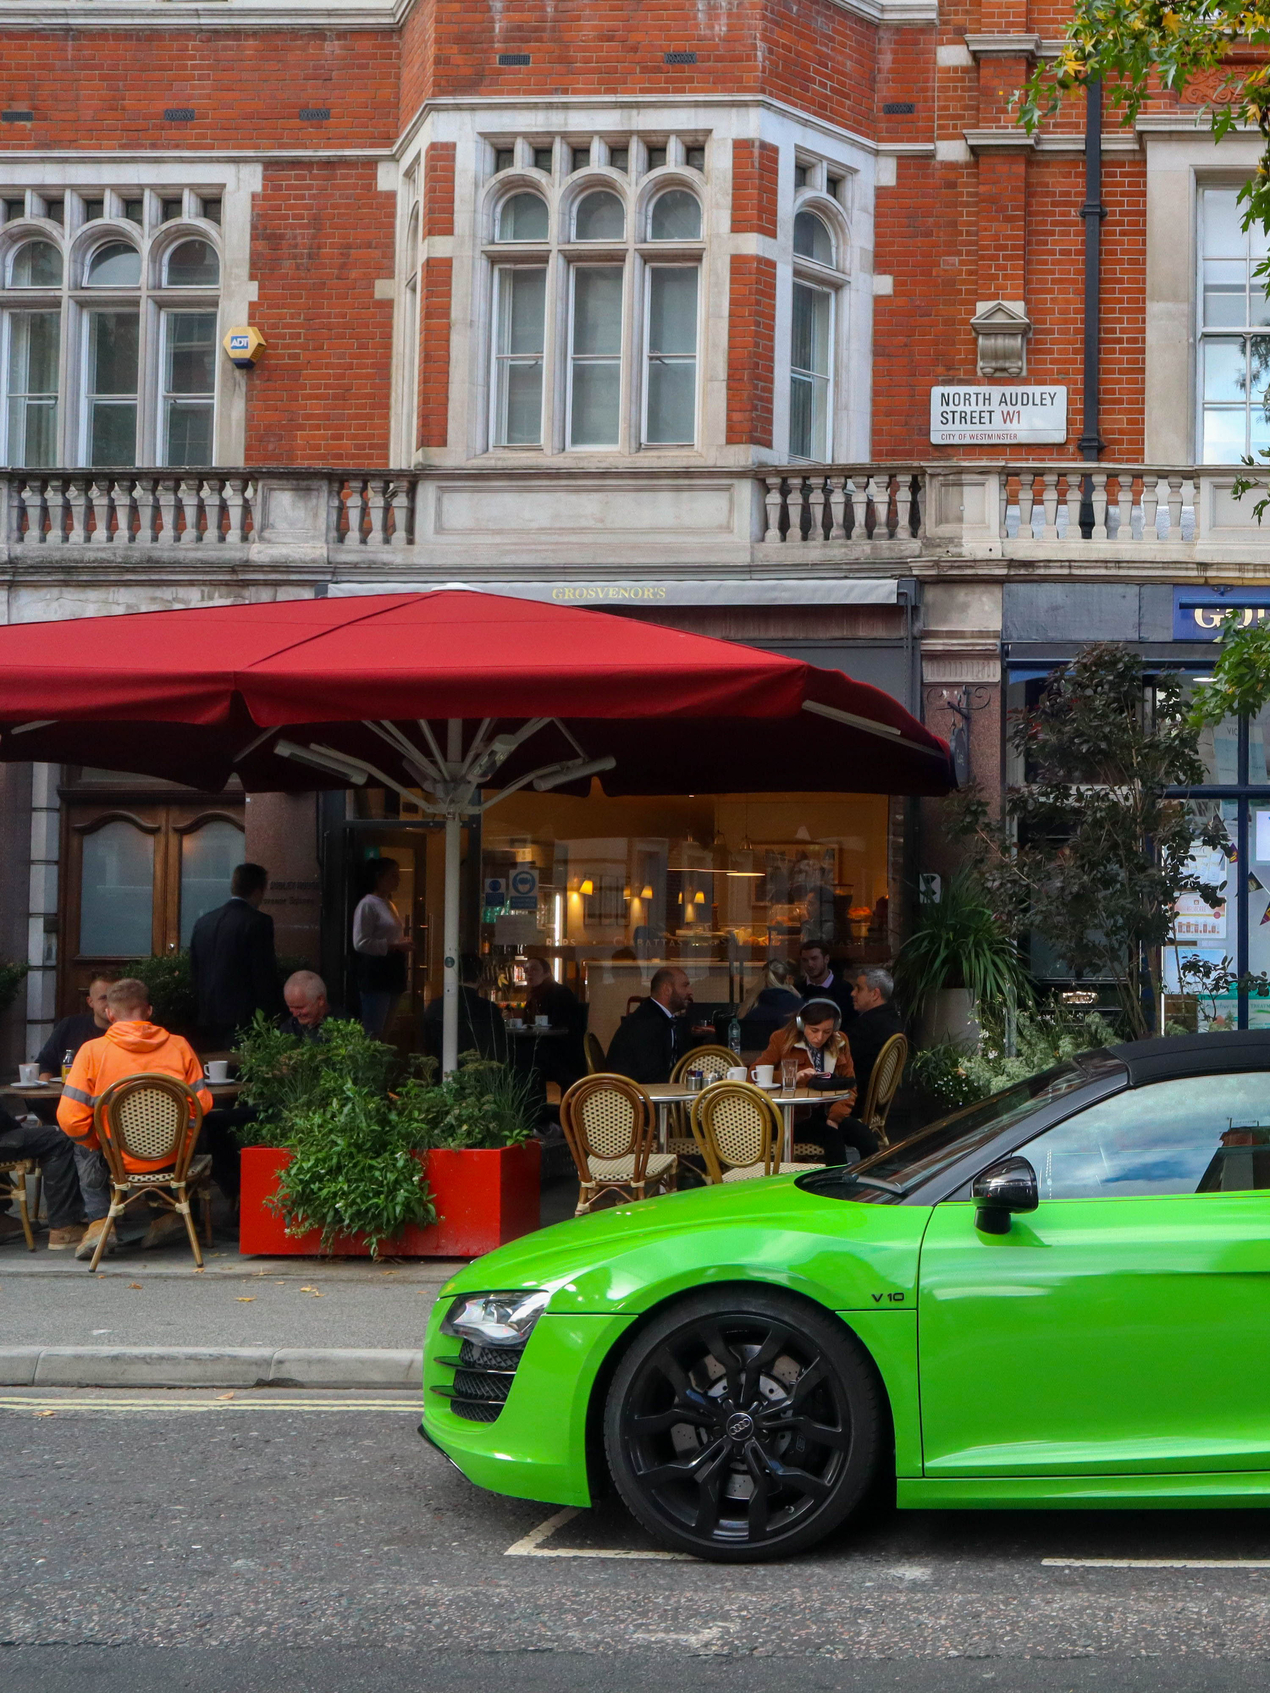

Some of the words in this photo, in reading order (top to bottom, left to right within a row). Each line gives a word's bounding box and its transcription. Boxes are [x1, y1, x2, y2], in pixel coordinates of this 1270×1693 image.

[231, 338, 250, 347] ADT
[940, 392, 992, 407] NORTH
[998, 391, 1057, 407] AUDLEY
[940, 410, 995, 425] STREET
[1001, 410, 1021, 425] W1
[940, 433, 956, 441] CITY
[958, 433, 967, 441] OF
[968, 433, 1018, 441] WESTMINSTER
[551, 586, 667, 600] GROSVENOR'S
[871, 1292, 905, 1302] V10
